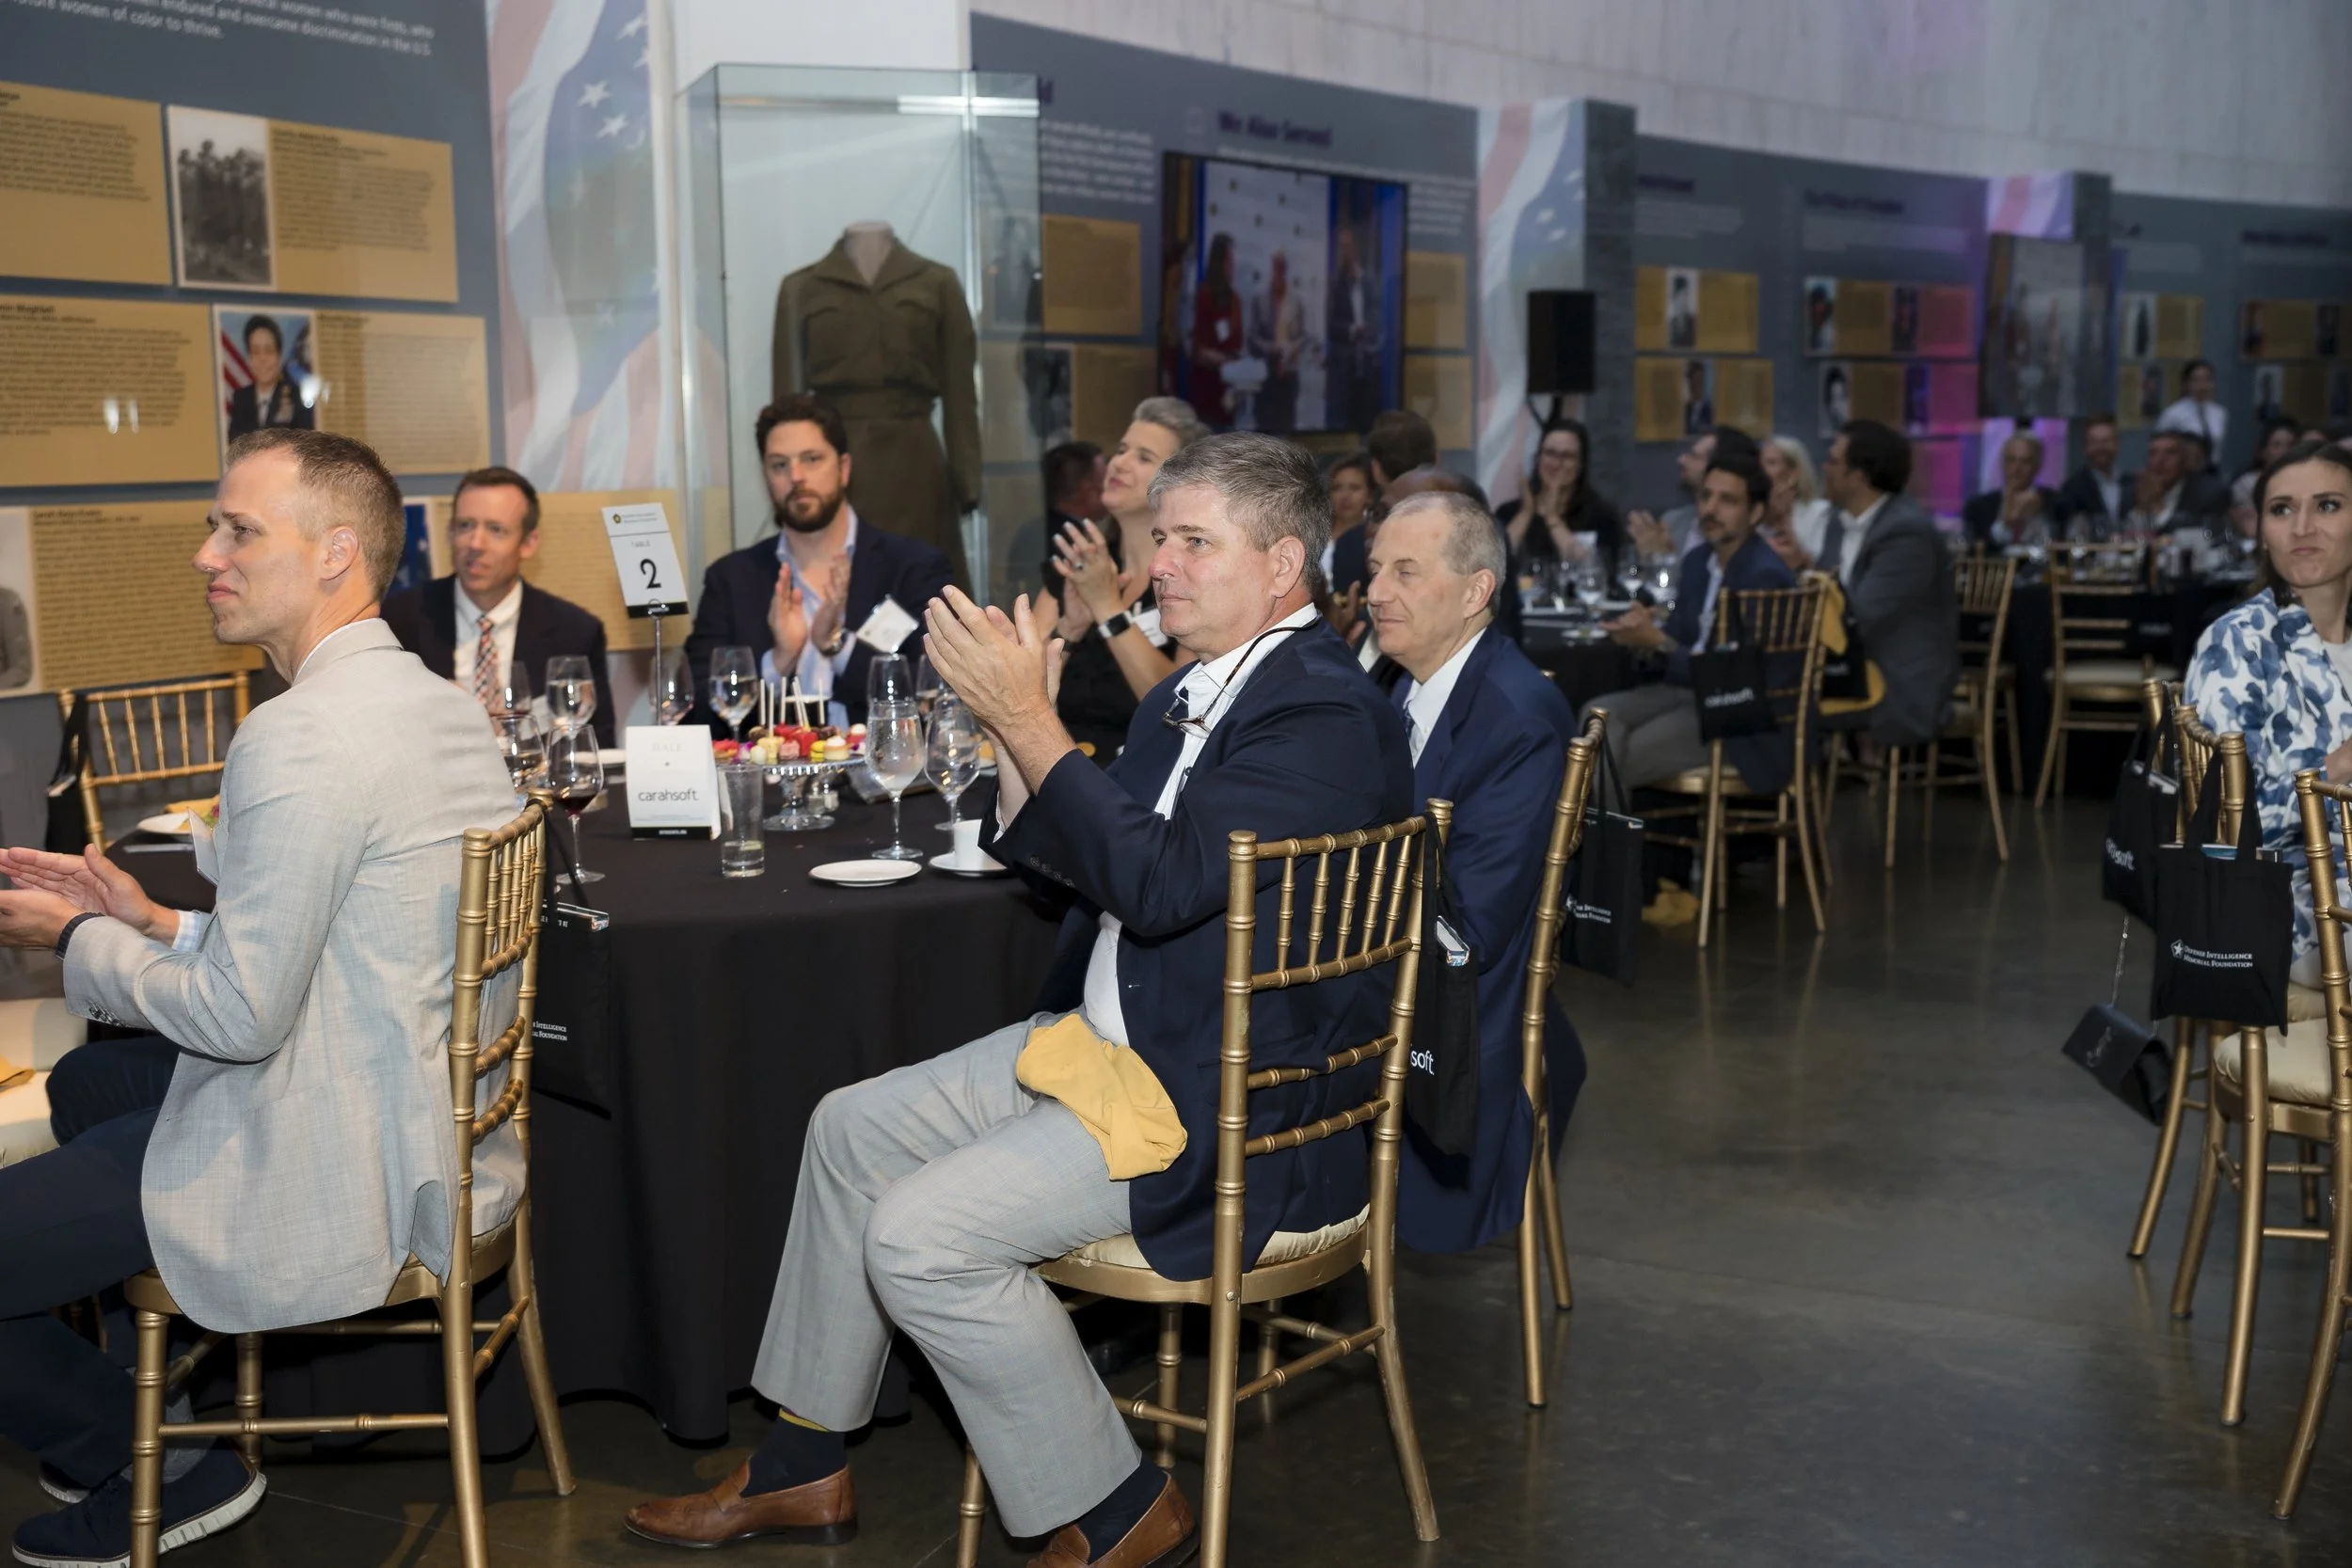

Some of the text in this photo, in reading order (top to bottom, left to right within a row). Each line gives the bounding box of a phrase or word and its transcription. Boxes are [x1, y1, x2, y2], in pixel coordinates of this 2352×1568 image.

[112, 7, 128, 22] of
[130, 11, 164, 29] color
[165, 16, 183, 32] to
[640, 558, 662, 591] 2
[637, 787, 700, 802] carahsoft
[2206, 950, 2253, 960] INTELLIGENCE
[2211, 959, 2254, 969] FOUNDATION
